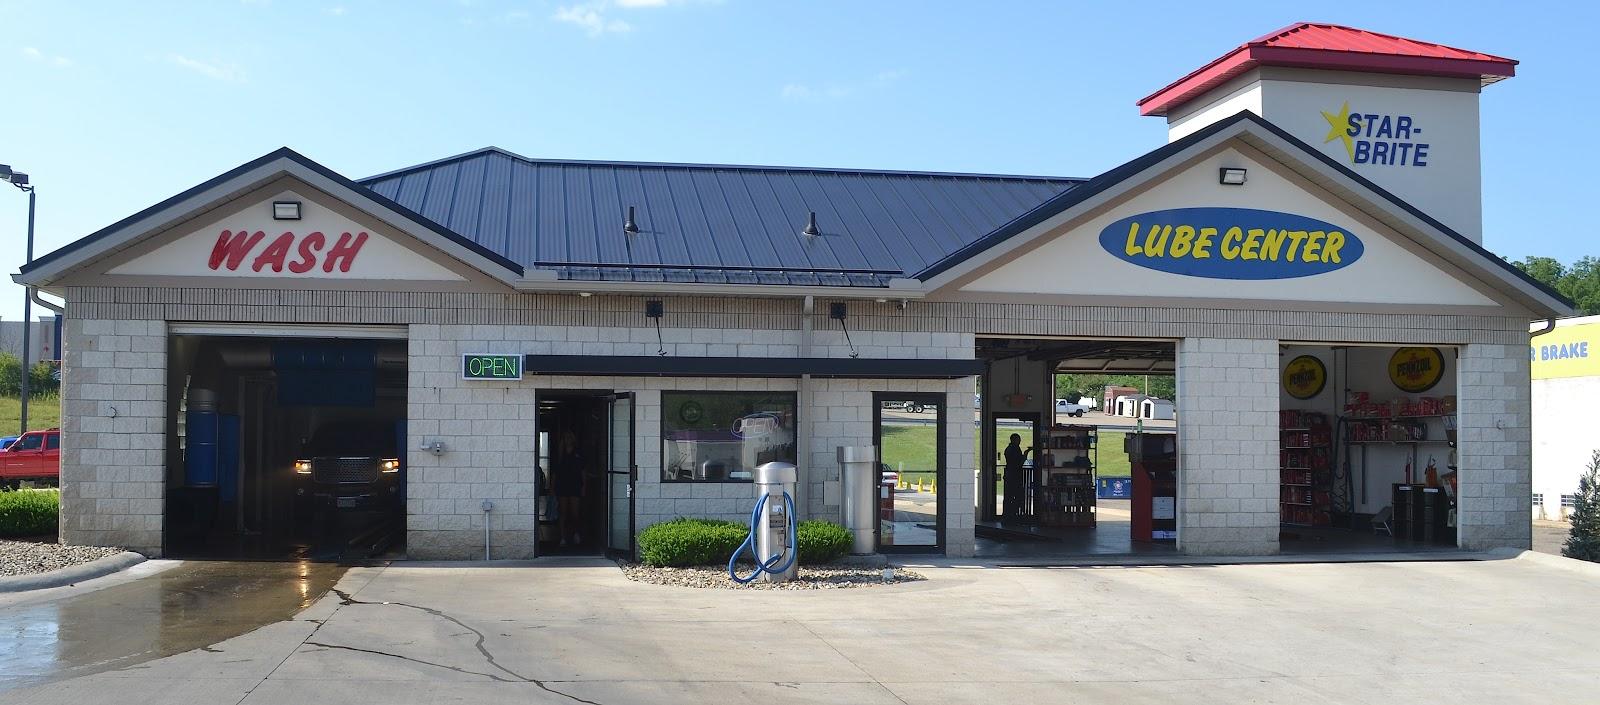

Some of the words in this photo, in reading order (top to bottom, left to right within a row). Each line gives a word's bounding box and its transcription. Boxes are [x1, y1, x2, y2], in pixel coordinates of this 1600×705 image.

[1346, 113, 1422, 139] STAR-
[1354, 141, 1430, 166] BRITE
[208, 229, 369, 273] WASH
[1125, 222, 1217, 259] LUBE
[1220, 226, 1346, 264] CENTER
[1541, 341, 1588, 361] BRAKE
[469, 357, 516, 376] OPEN
[732, 418, 777, 433] OPEN
